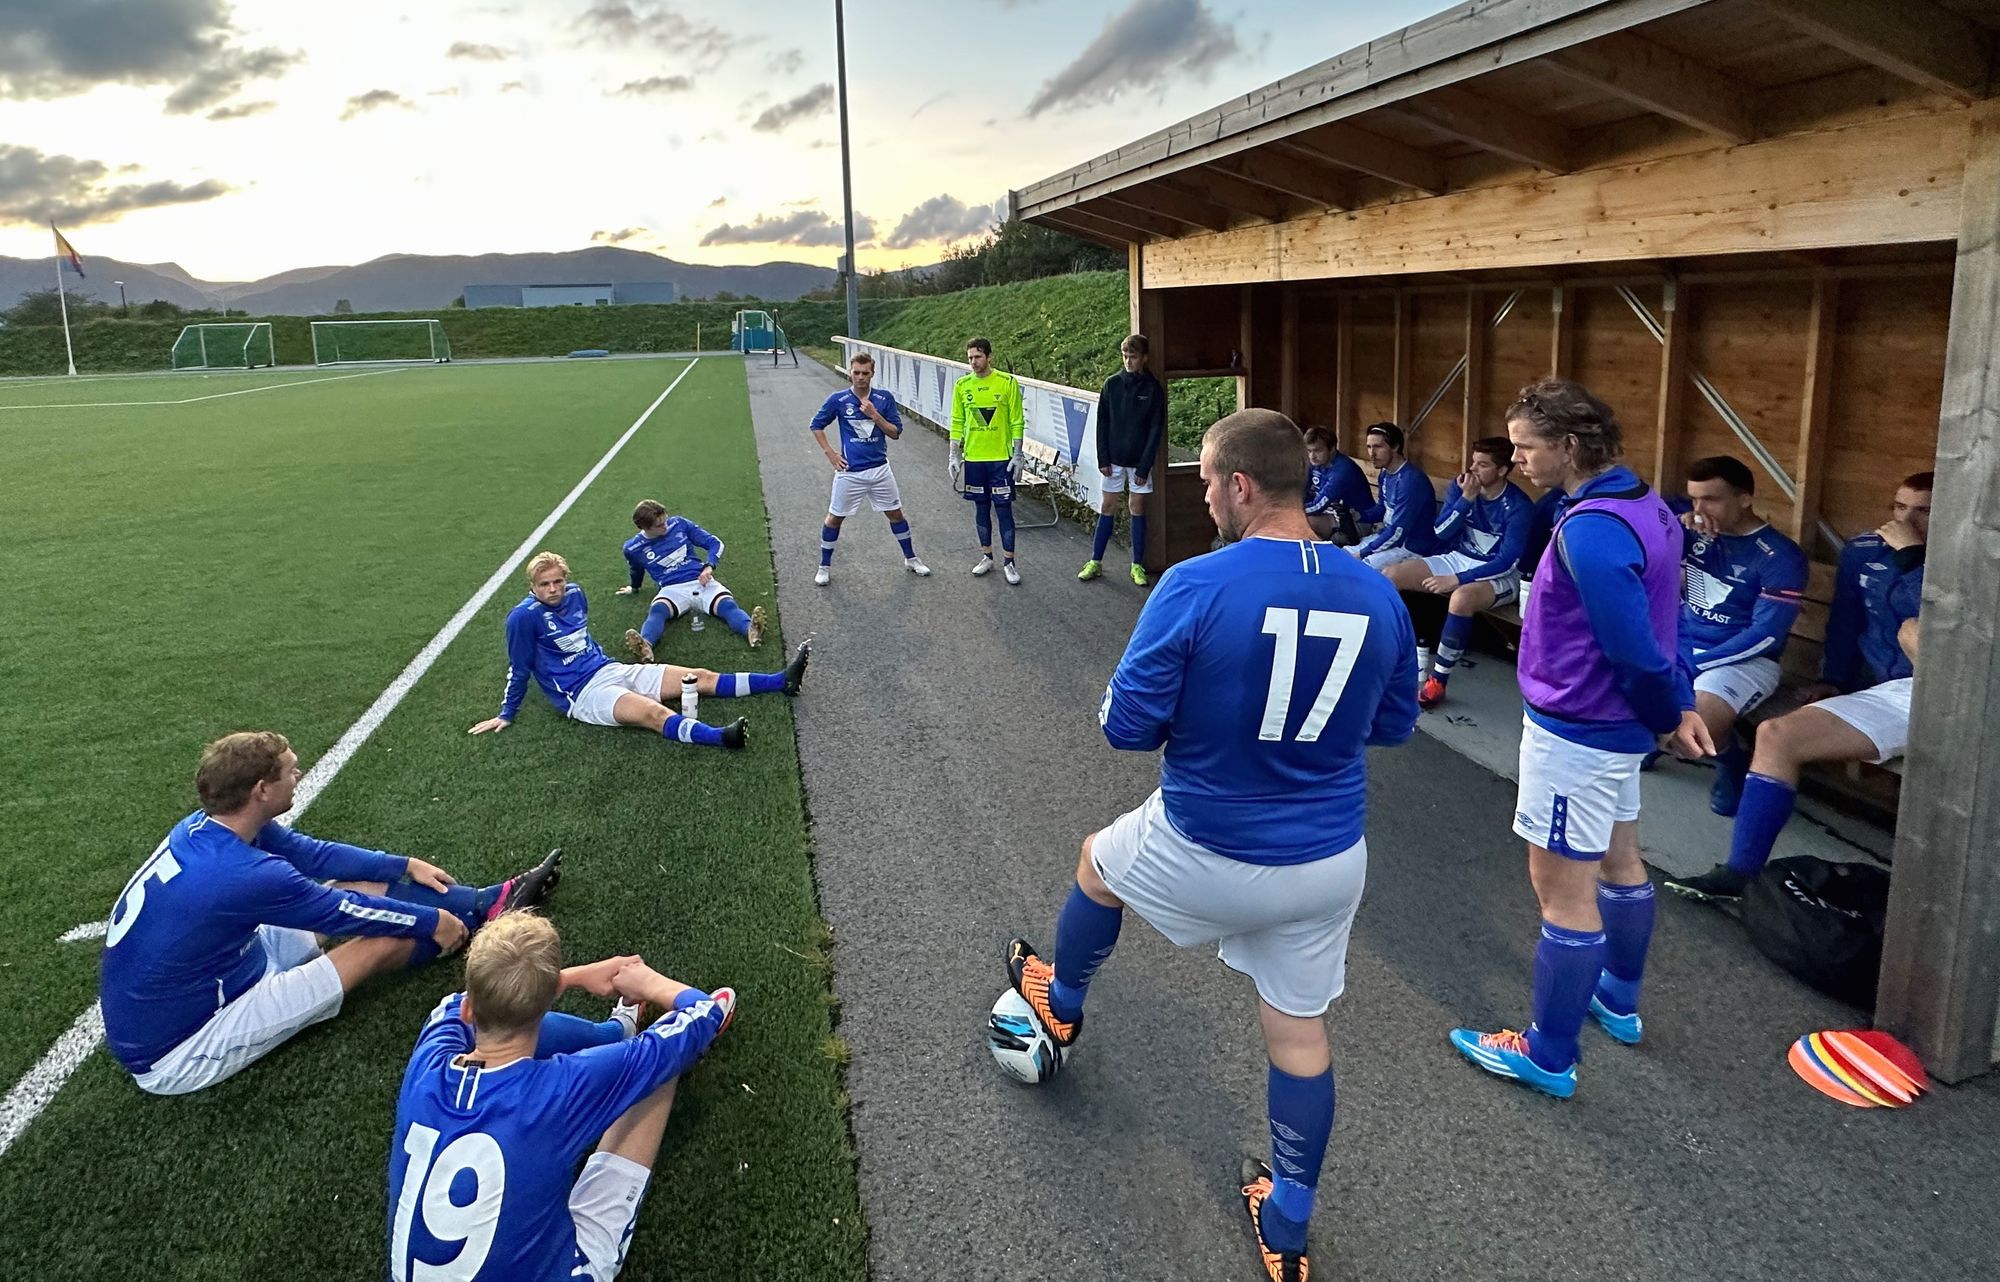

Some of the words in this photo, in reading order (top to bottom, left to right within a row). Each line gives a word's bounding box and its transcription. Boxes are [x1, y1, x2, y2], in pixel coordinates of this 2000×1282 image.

[1258, 606, 1370, 742] 17
[1702, 610, 1731, 624] PLAST
[391, 1121, 505, 1282] 19
